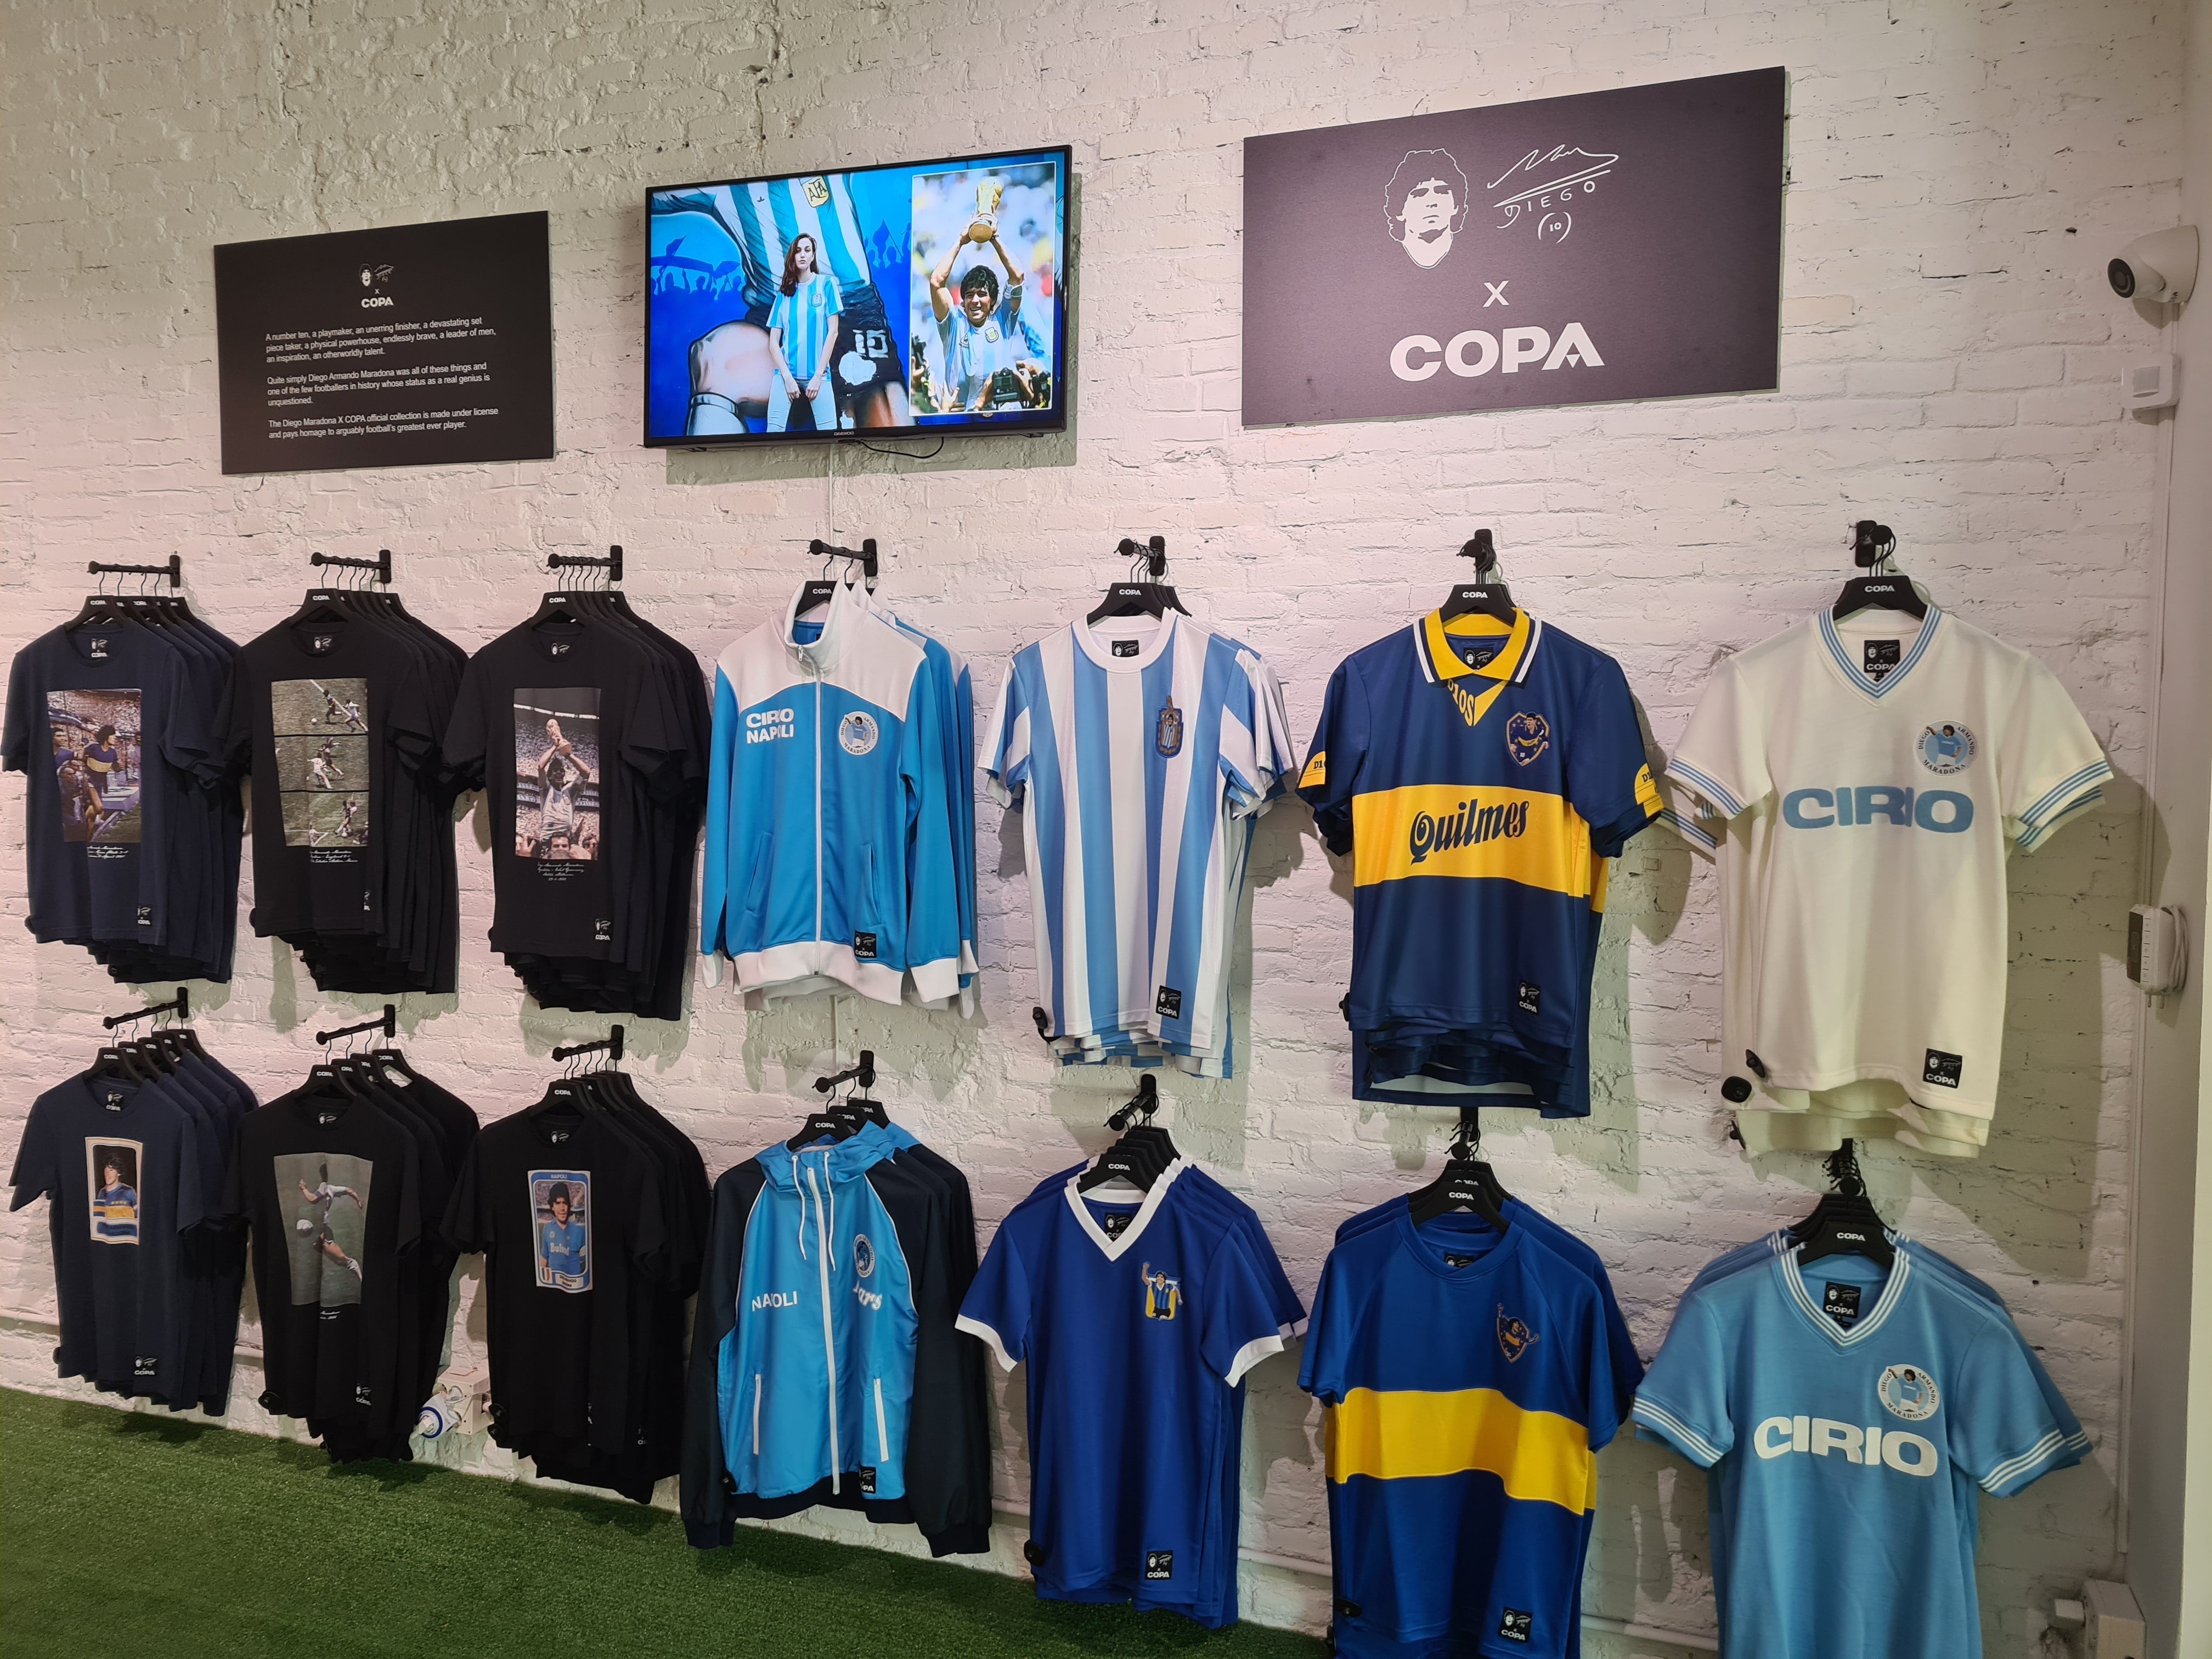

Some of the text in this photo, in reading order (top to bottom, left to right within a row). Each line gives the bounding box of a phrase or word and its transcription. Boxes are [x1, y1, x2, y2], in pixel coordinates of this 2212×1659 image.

[361, 296, 394, 308] COPA
[272, 332, 297, 340] number
[365, 325, 393, 333] unerring
[429, 319, 469, 328] devastating
[266, 345, 284, 353] piece
[311, 339, 337, 350] physical
[383, 334, 415, 343] endlessly
[1390, 323, 1605, 381] COPA
[323, 349, 363, 358] otherworldly
[286, 375, 307, 384] simply
[308, 374, 328, 382] Diego
[329, 371, 359, 380] Armando
[360, 369, 394, 377] Maradona
[450, 364, 472, 373] things
[314, 383, 348, 392] footballers
[358, 381, 380, 390] history
[405, 378, 426, 386] status
[459, 375, 482, 384] genius
[283, 419, 302, 428] Diego
[303, 417, 336, 425] Maradona
[345, 415, 366, 423] COPA
[366, 414, 388, 422] official
[390, 412, 421, 420] collection
[300, 429, 326, 437] homage
[336, 426, 364, 436] arguably
[366, 424, 396, 433] football's
[397, 422, 425, 432] greatest
[844, 742, 870, 754] MARADONA
[1918, 731, 1930, 749] DIEGO
[1956, 726, 1975, 755] ARMANDO
[1923, 759, 1966, 774] MARADONA
[1783, 786, 1974, 833] CIRIO
[1410, 799, 1530, 866] Quilmes
[1158, 1006, 1177, 1017] COPA
[1519, 1001, 1537, 1013] COPA
[1926, 1073, 1956, 1086] COPA
[1837, 1232, 1865, 1242] COPA
[752, 1290, 798, 1312] NAOLI
[1826, 1305, 1855, 1315] COPA
[1882, 1373, 1892, 1392] DIEGO
[1918, 1372, 1936, 1404] ARMANDO
[1887, 1402, 1928, 1419] MARADONA
[1754, 1415, 1938, 1477] CIRIO
[1501, 1629, 1525, 1640] COPA
